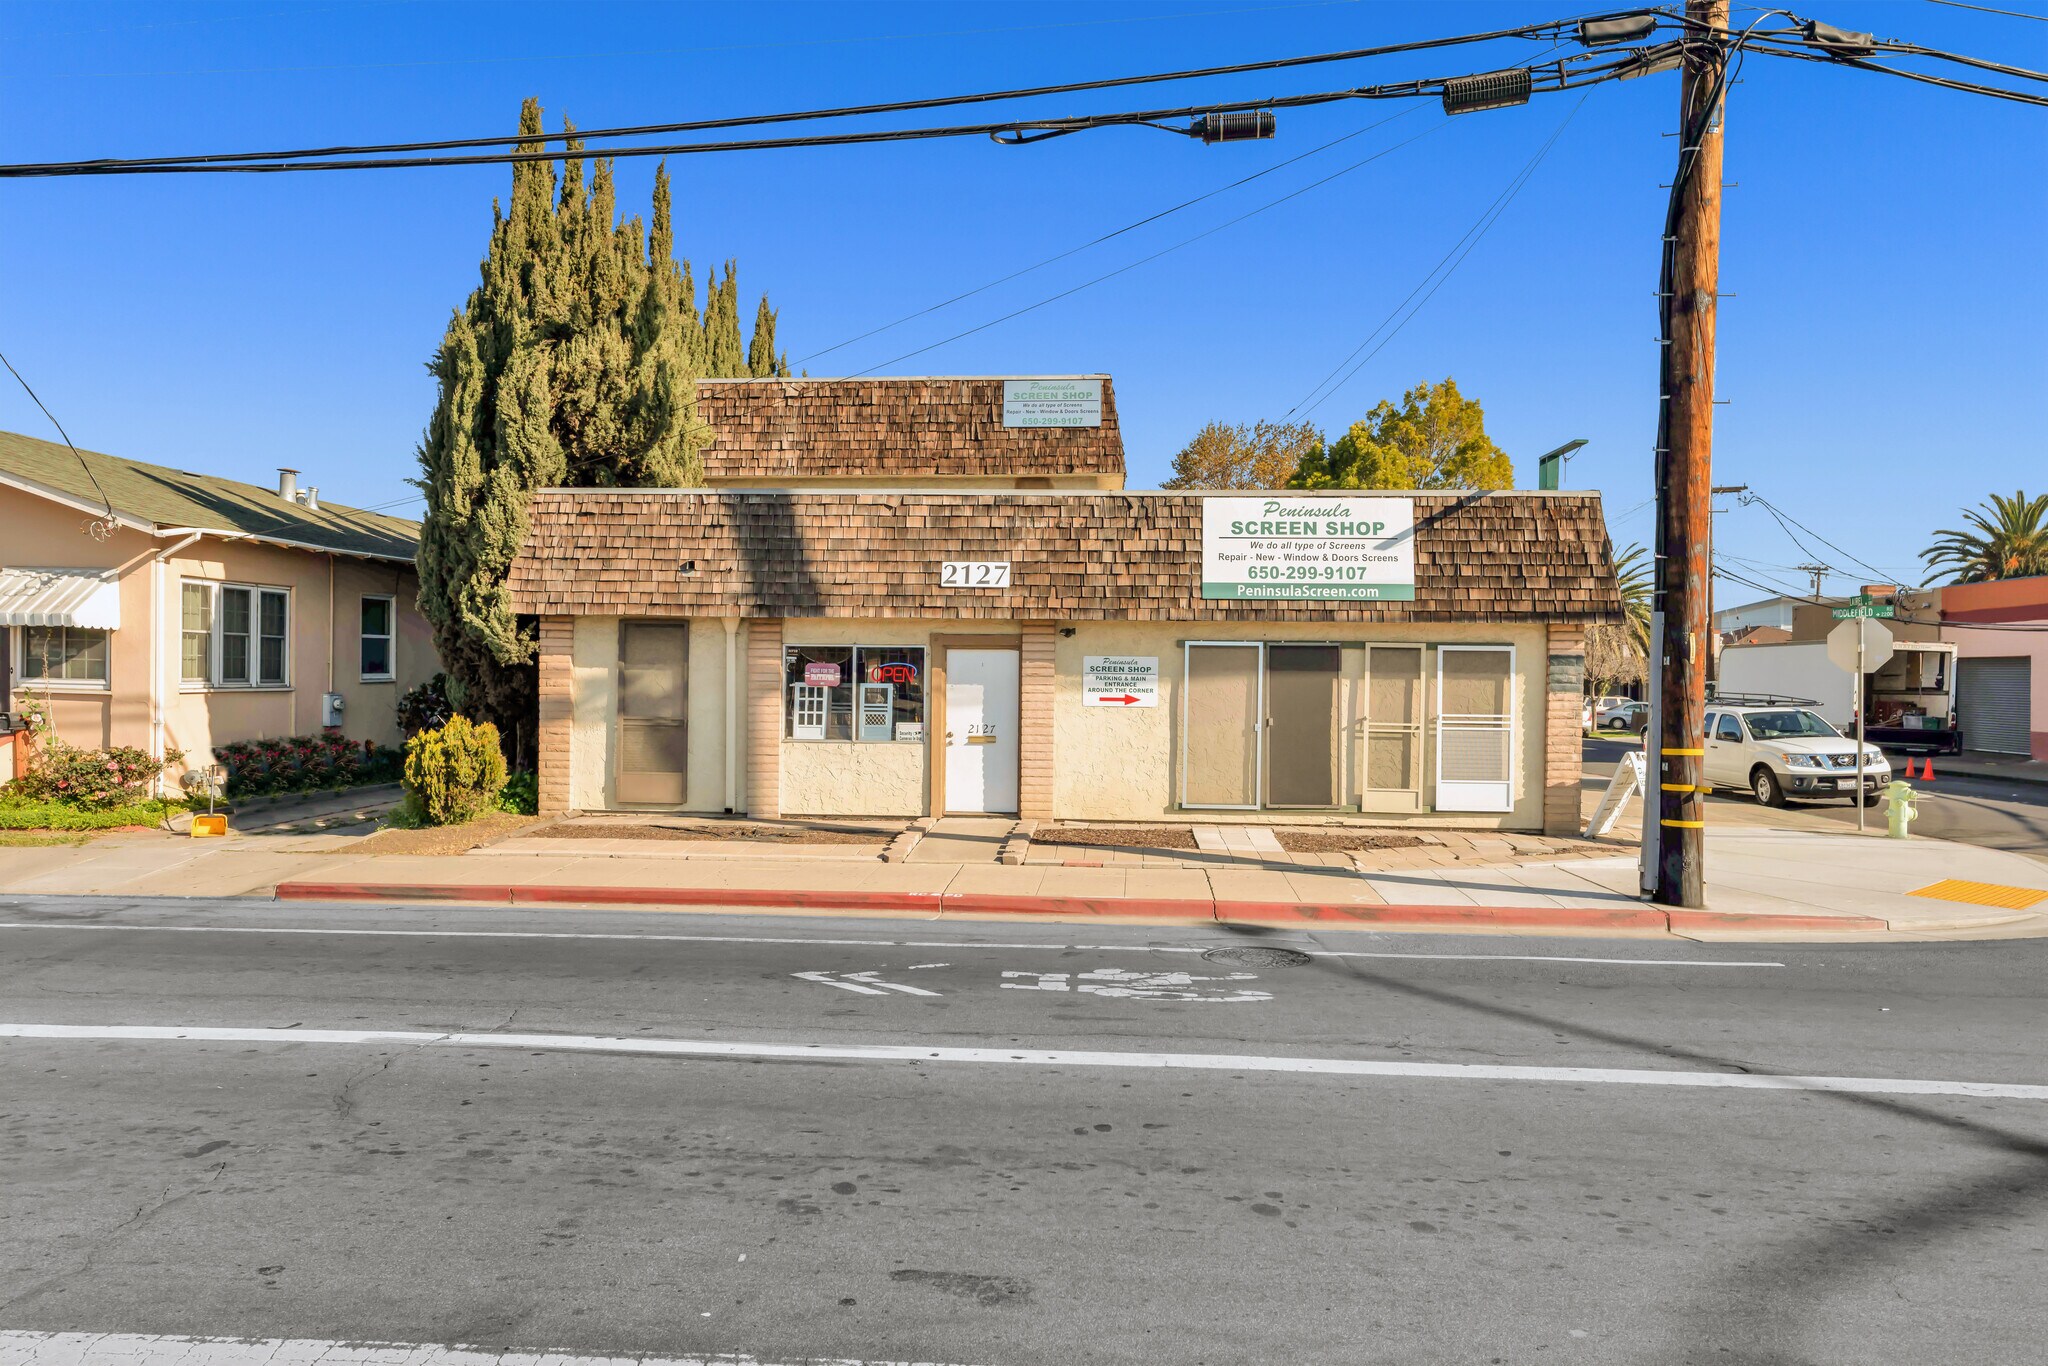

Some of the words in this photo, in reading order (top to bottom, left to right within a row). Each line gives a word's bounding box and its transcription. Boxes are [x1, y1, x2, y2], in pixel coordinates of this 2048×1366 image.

[1030, 382, 1075, 391] Peninsula
[1013, 392, 1058, 400] SCREEN
[1062, 391, 1093, 400] SHOP
[1022, 417, 1083, 425] 650-299-9107
[1263, 501, 1352, 518] Peninsula
[1231, 521, 1318, 536] SCREEN
[1325, 521, 1385, 536] SHOP
[1250, 541, 1264, 549] We
[1266, 541, 1278, 550] do
[1280, 541, 1292, 550] all
[1294, 541, 1314, 551] type
[1316, 541, 1327, 550] of
[1329, 541, 1366, 550] Screens
[1218, 552, 1247, 562] Repair
[1255, 553, 1275, 561] New
[1283, 553, 1320, 562] Window
[1322, 553, 1329, 562] &
[1331, 553, 1359, 562] Doors
[1361, 553, 1399, 562] Screens
[943, 564, 1009, 585] 2127
[1248, 565, 1367, 580] 650-299-9107
[1237, 584, 1379, 597] PeninsulaScreen.com
[1832, 607, 1874, 618] MIDDLEFIELD
[1102, 657, 1138, 666] Peninsula
[1089, 665, 1125, 673] SCREEN
[871, 666, 915, 683] OPEN
[968, 724, 996, 734] 2127
